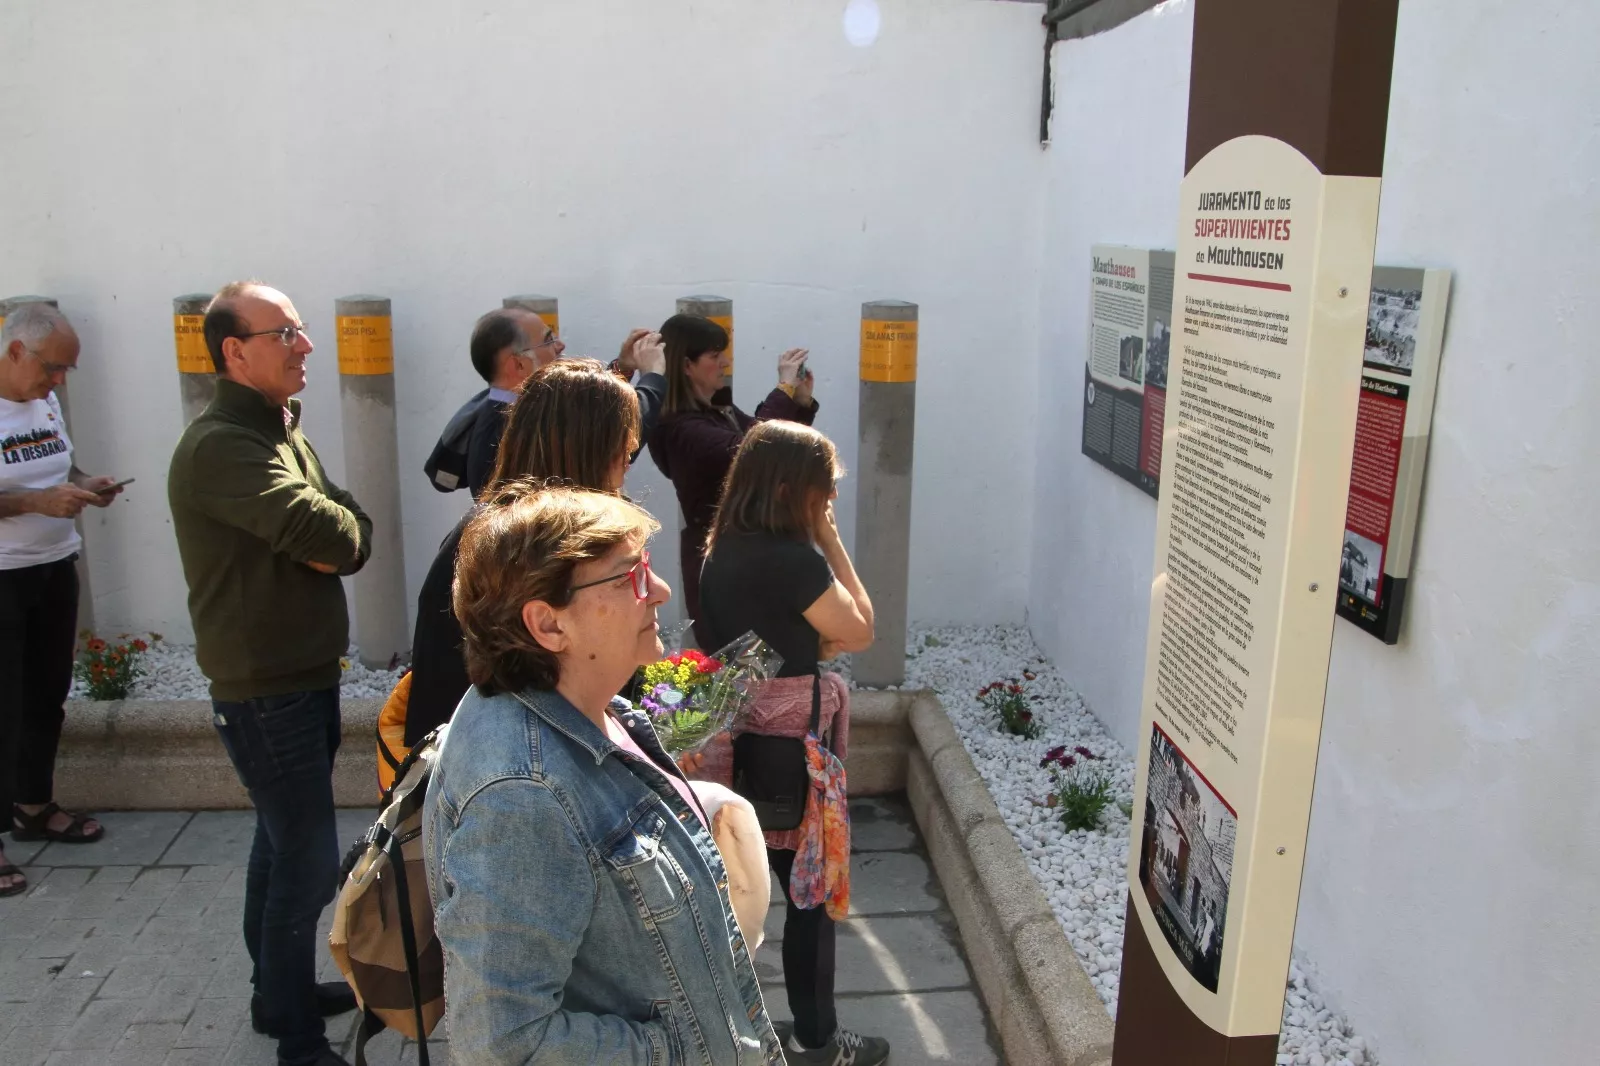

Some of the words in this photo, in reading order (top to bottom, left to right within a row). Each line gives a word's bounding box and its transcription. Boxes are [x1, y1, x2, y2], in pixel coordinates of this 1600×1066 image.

[1198, 190, 1262, 211] JURAMENTO
[1264, 197, 1275, 211] de
[1277, 196, 1291, 211] los
[1194, 218, 1291, 241] SUPERVIVIENTES
[1196, 250, 1205, 263] de
[1092, 256, 1136, 279] Mauthausen
[3, 449, 21, 464] LA
